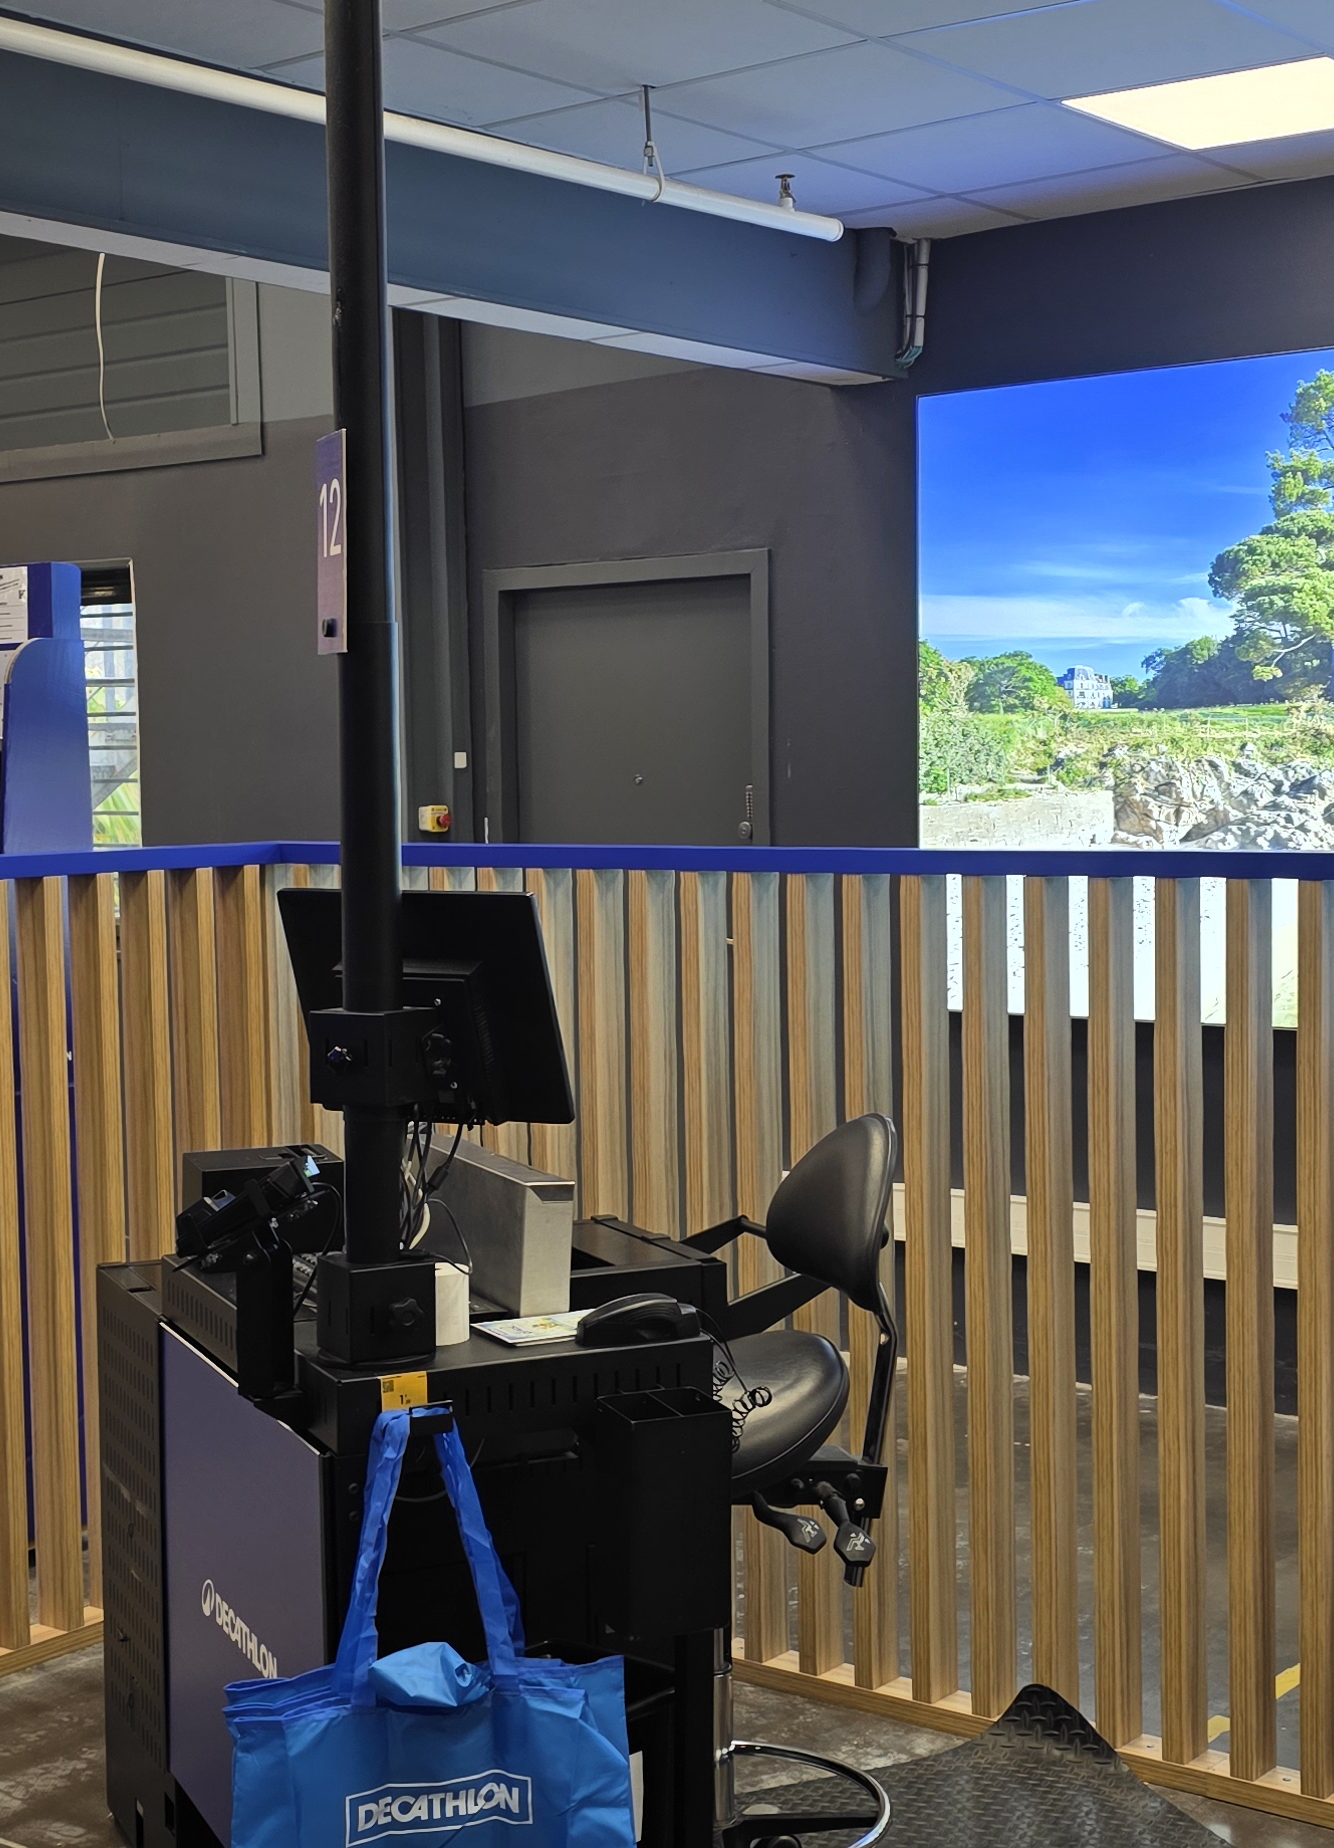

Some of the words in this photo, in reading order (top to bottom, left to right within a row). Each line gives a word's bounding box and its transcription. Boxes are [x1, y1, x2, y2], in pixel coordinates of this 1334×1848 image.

[320, 478, 342, 557] 12
[216, 1592, 278, 1679] DECATHLON
[357, 1782, 520, 1832] DECATHLON
